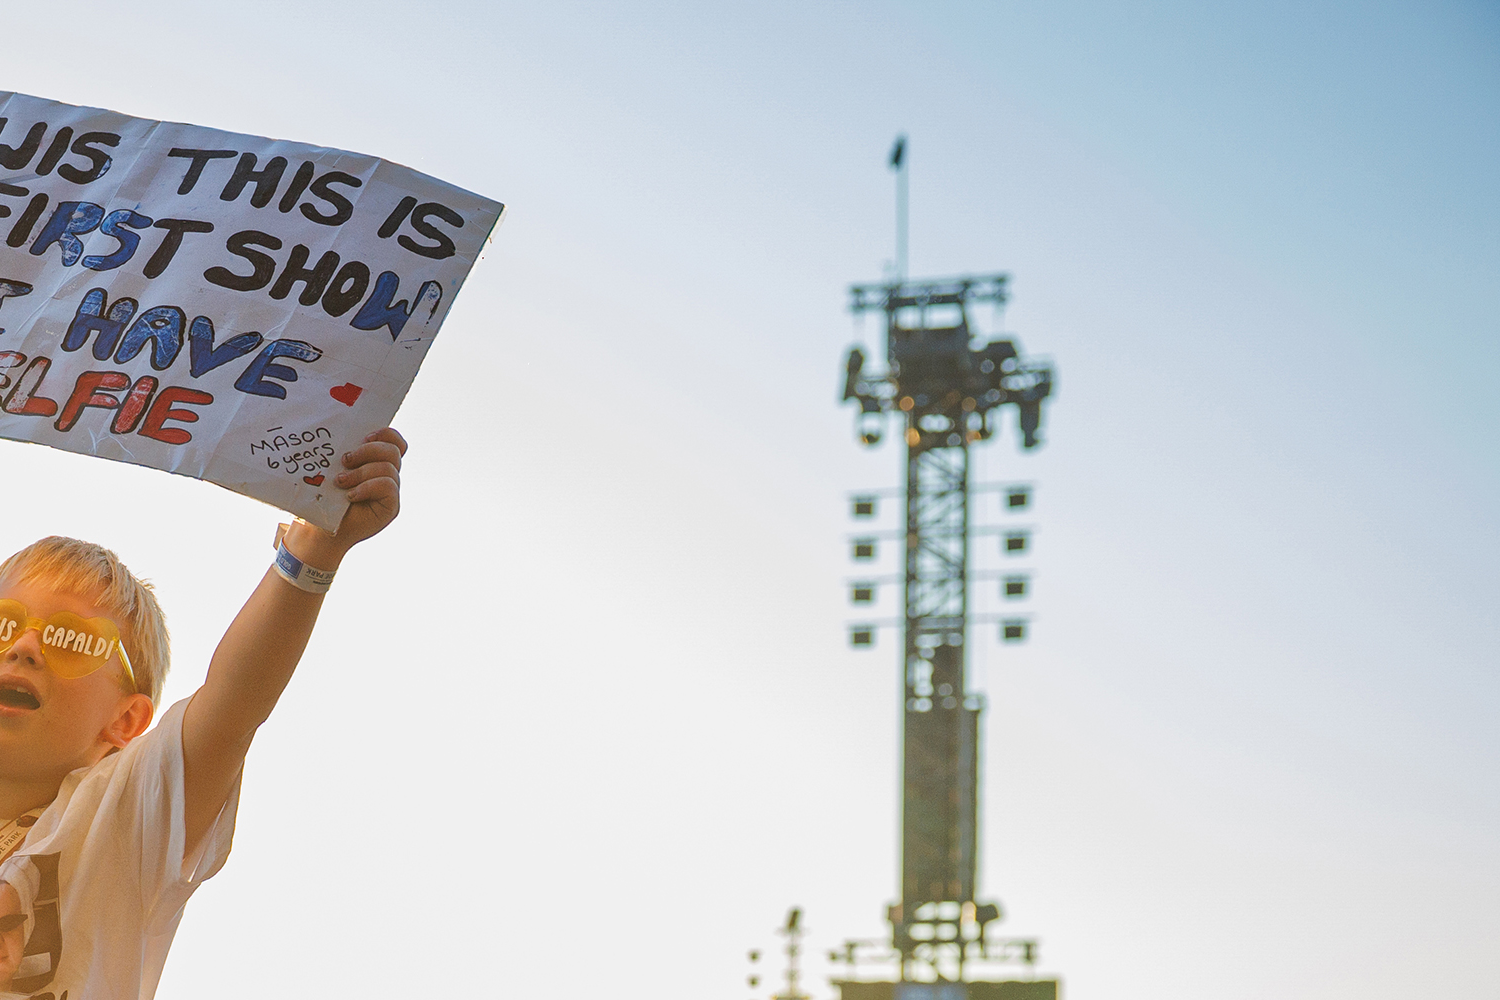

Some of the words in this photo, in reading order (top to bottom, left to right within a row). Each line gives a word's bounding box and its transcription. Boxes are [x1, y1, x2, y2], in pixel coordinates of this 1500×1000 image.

[167, 147, 362, 227] THIS
[377, 195, 465, 260] IS
[203, 229, 443, 343] SHOW
[61, 287, 324, 400] HAVE
[267, 457, 280, 469] 6
[283, 443, 335, 474] years
[303, 454, 330, 471] old
[42, 624, 114, 660] CAPALDI
[4, 831, 22, 847] PARK
